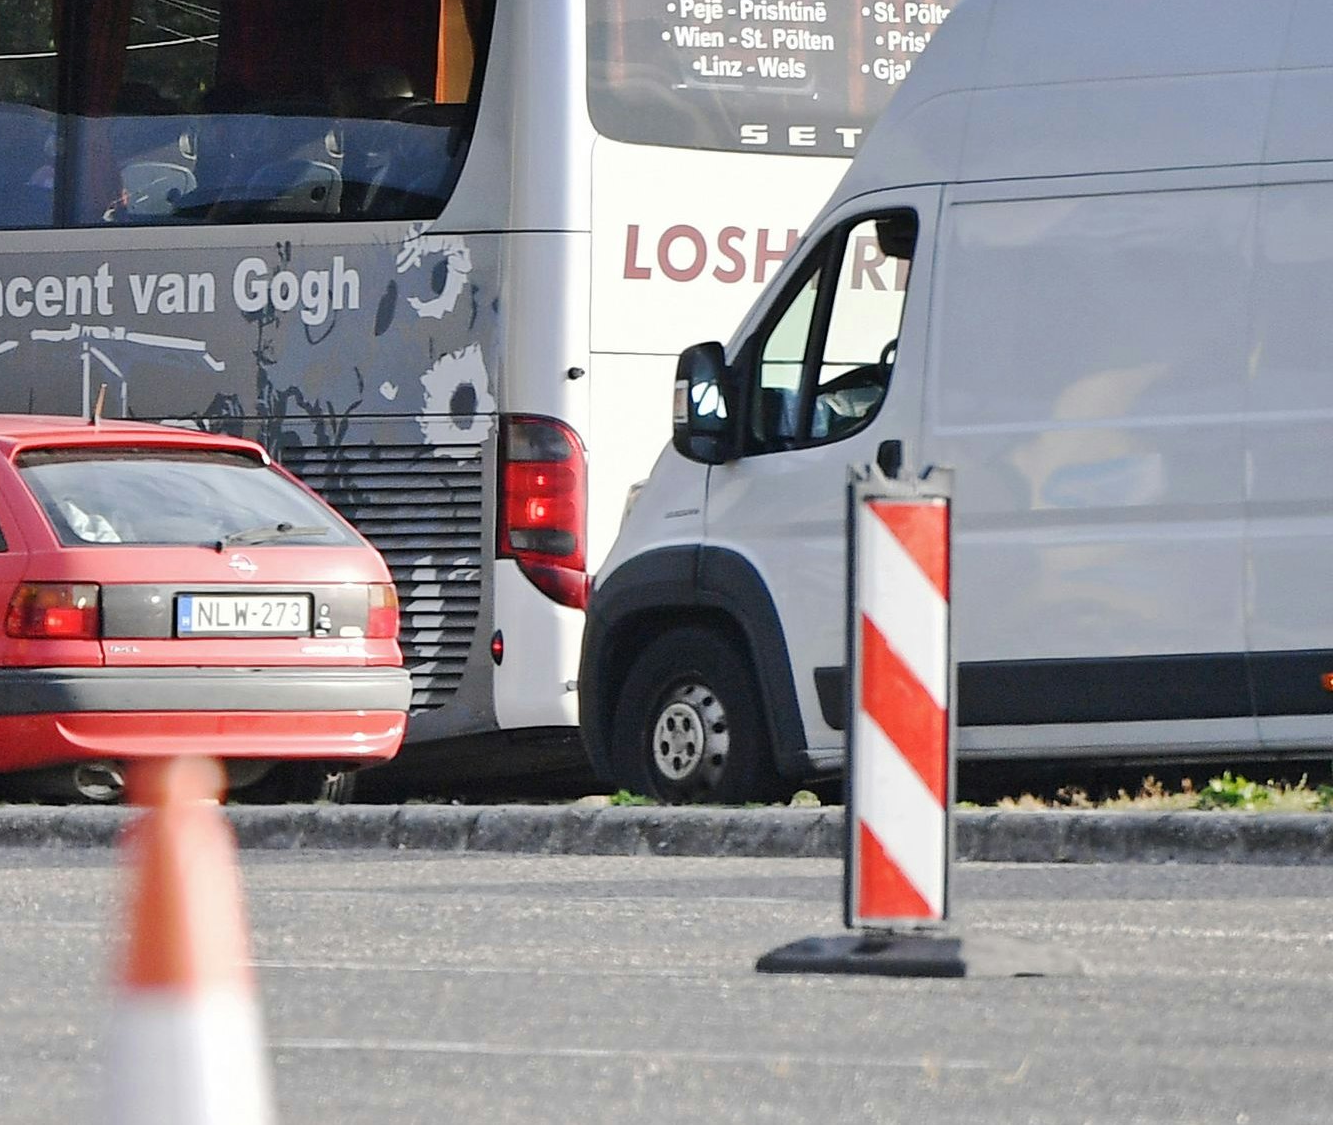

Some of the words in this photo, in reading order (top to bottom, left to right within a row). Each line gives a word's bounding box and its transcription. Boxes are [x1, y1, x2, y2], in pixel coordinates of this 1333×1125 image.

[740, 0, 827, 22] Prishtinë
[904, 2, 951, 24] Pölt
[674, 26, 724, 47] Wien
[773, 29, 835, 51] Pölten
[700, 55, 743, 77] Linz
[758, 56, 806, 78] Wels
[740, 124, 863, 148] SET
[623, 224, 820, 290] LOSH
[128, 272, 215, 314] van
[232, 256, 361, 326] Gogh
[198, 602, 301, 627] NLW-273
